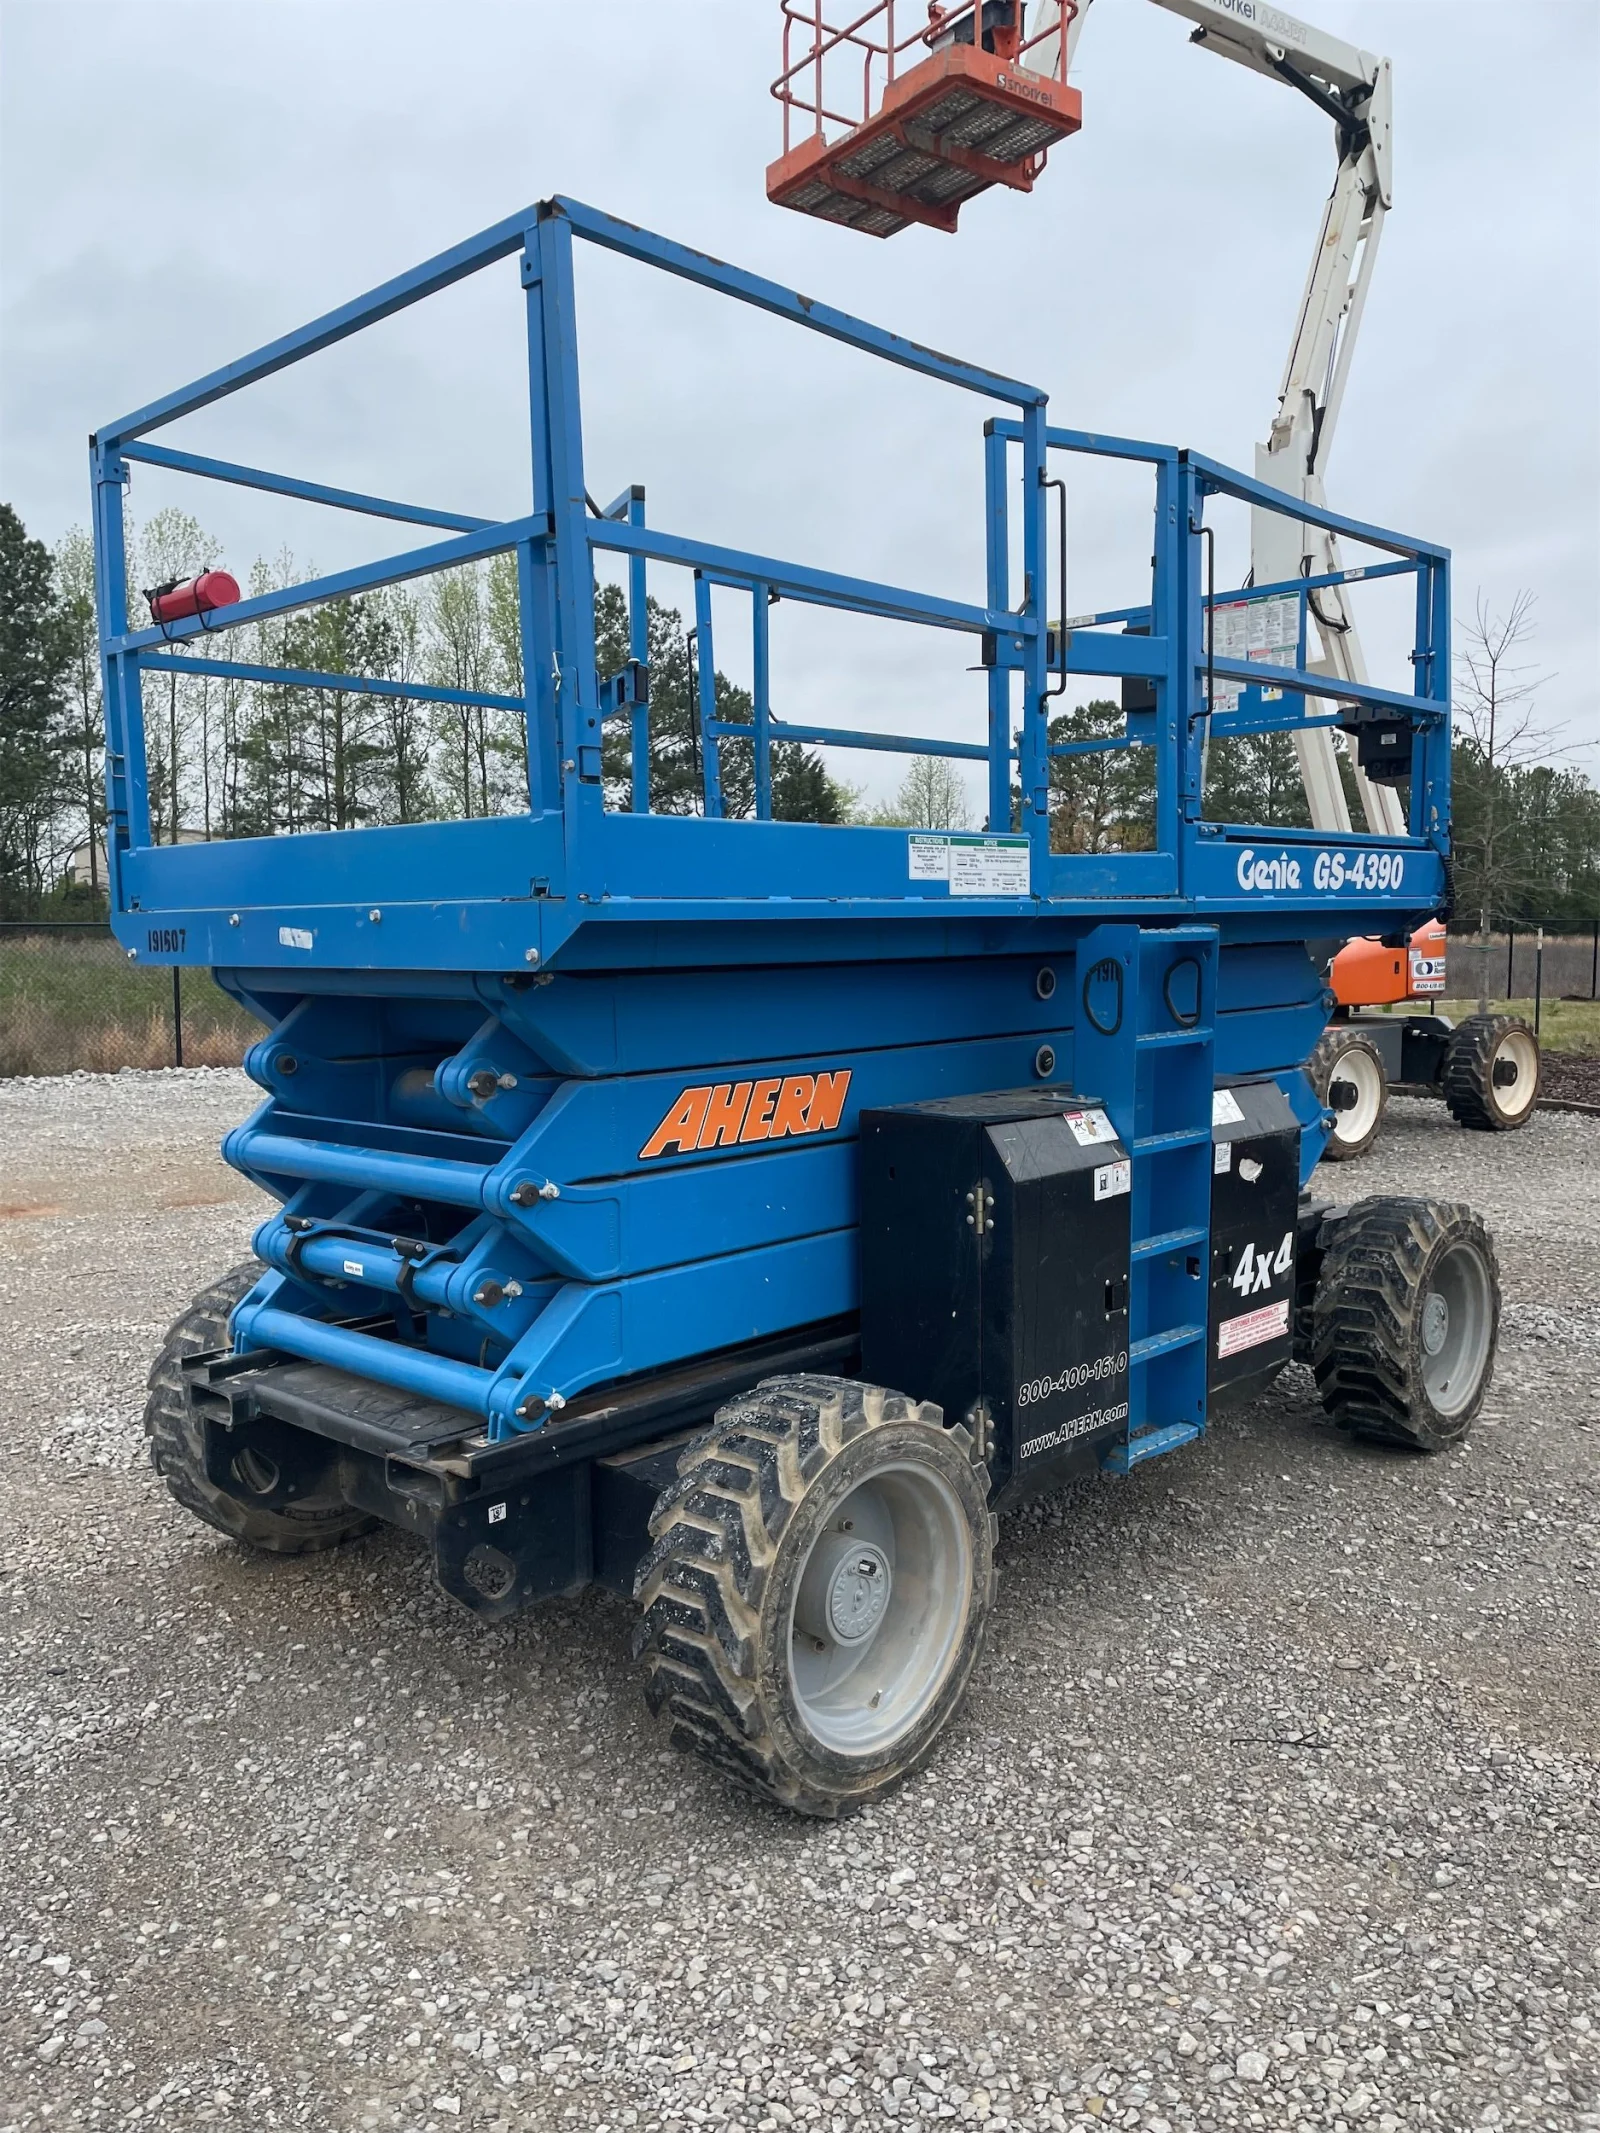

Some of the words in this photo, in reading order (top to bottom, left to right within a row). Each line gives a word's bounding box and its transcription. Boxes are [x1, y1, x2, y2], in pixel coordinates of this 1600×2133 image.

[1237, 850, 1302, 890] Genie
[1313, 852, 1404, 890] GS-4390
[148, 928, 186, 952] 191607
[639, 1070, 852, 1158] AHERN
[1233, 1231, 1293, 1296] 4x4
[1018, 1351, 1127, 1406] 800-400-1610
